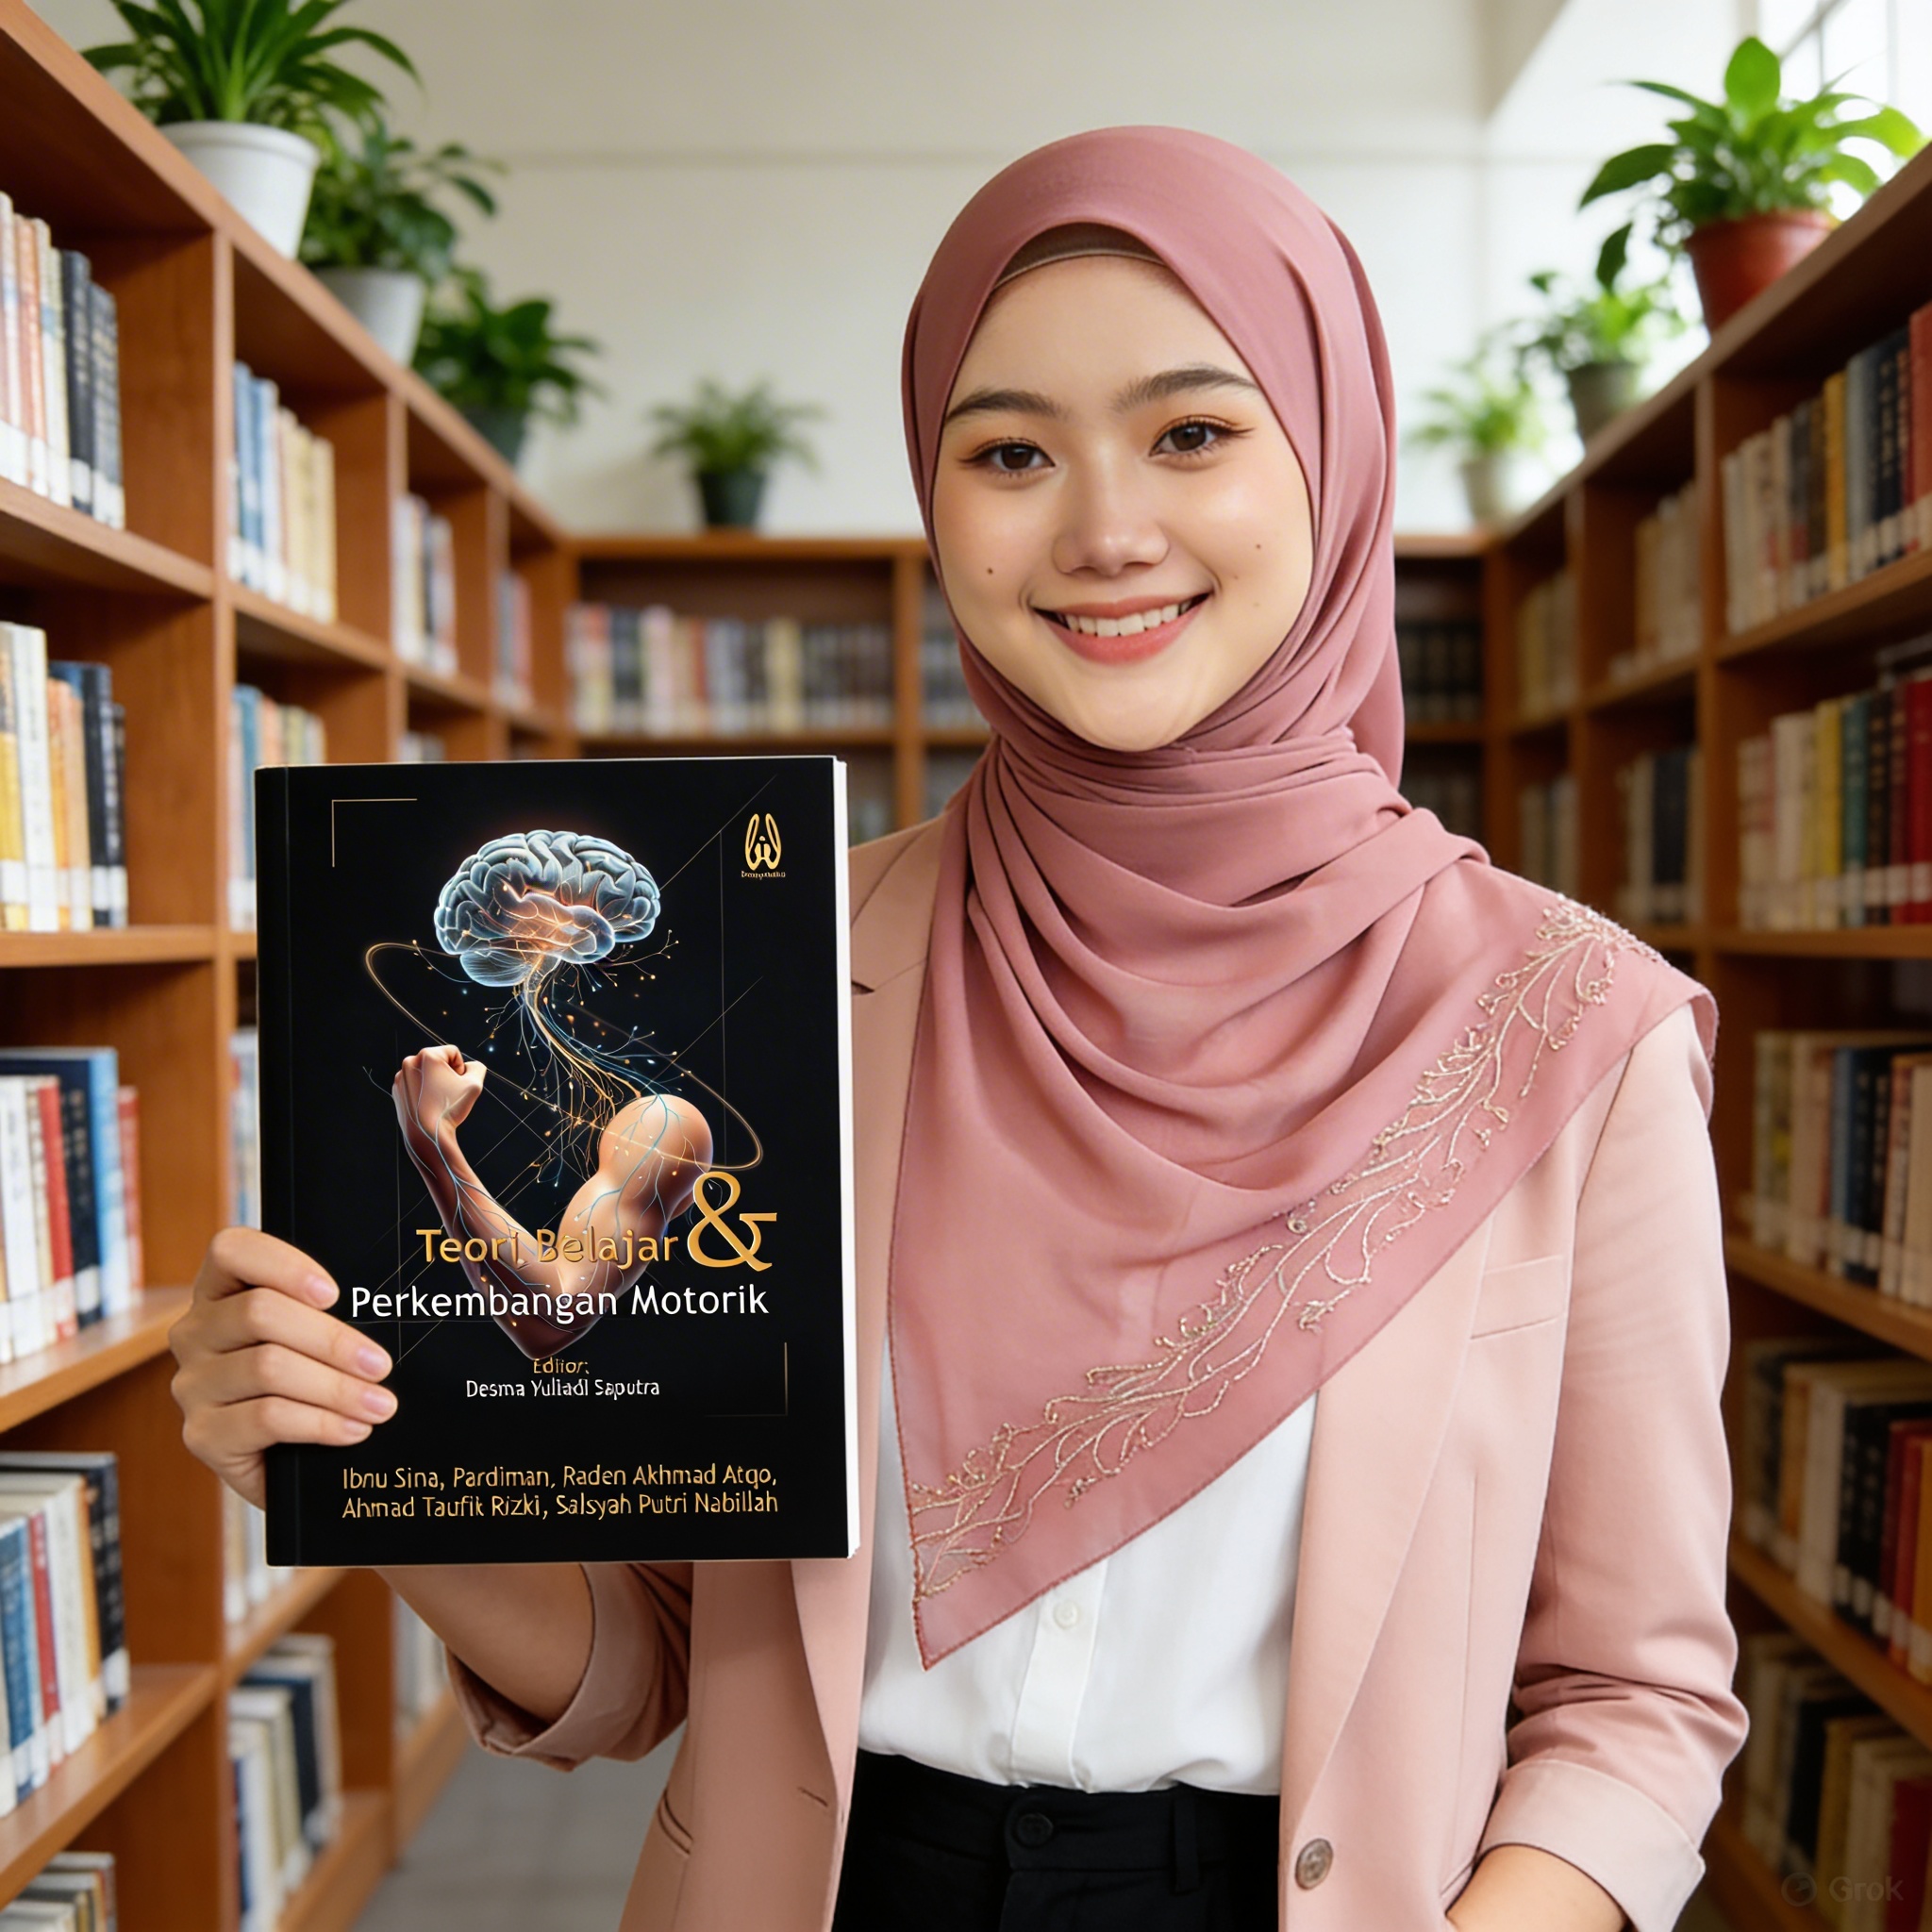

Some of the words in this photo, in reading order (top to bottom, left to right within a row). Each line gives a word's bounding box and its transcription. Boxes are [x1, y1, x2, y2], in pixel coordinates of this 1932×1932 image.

[536, 1227, 679, 1269] Belajar
[687, 1171, 777, 1272] &
[351, 1287, 618, 1324] Perkembangan
[631, 1284, 769, 1315] Motorik
[466, 1380, 525, 1397] Desma
[594, 1379, 659, 1400] Saputra
[342, 1467, 387, 1489] Ibnu
[393, 1468, 445, 1491] Sina,
[453, 1466, 556, 1490] Pardiman,
[563, 1464, 626, 1488] Raden
[632, 1463, 716, 1486] Akhmad
[341, 1496, 415, 1518] Ahmad
[422, 1495, 485, 1517] Taufik
[491, 1492, 548, 1520] Rizki,
[556, 1491, 632, 1520] Salsyah
[639, 1492, 687, 1514] Putri
[694, 1490, 778, 1513] Nabillah
